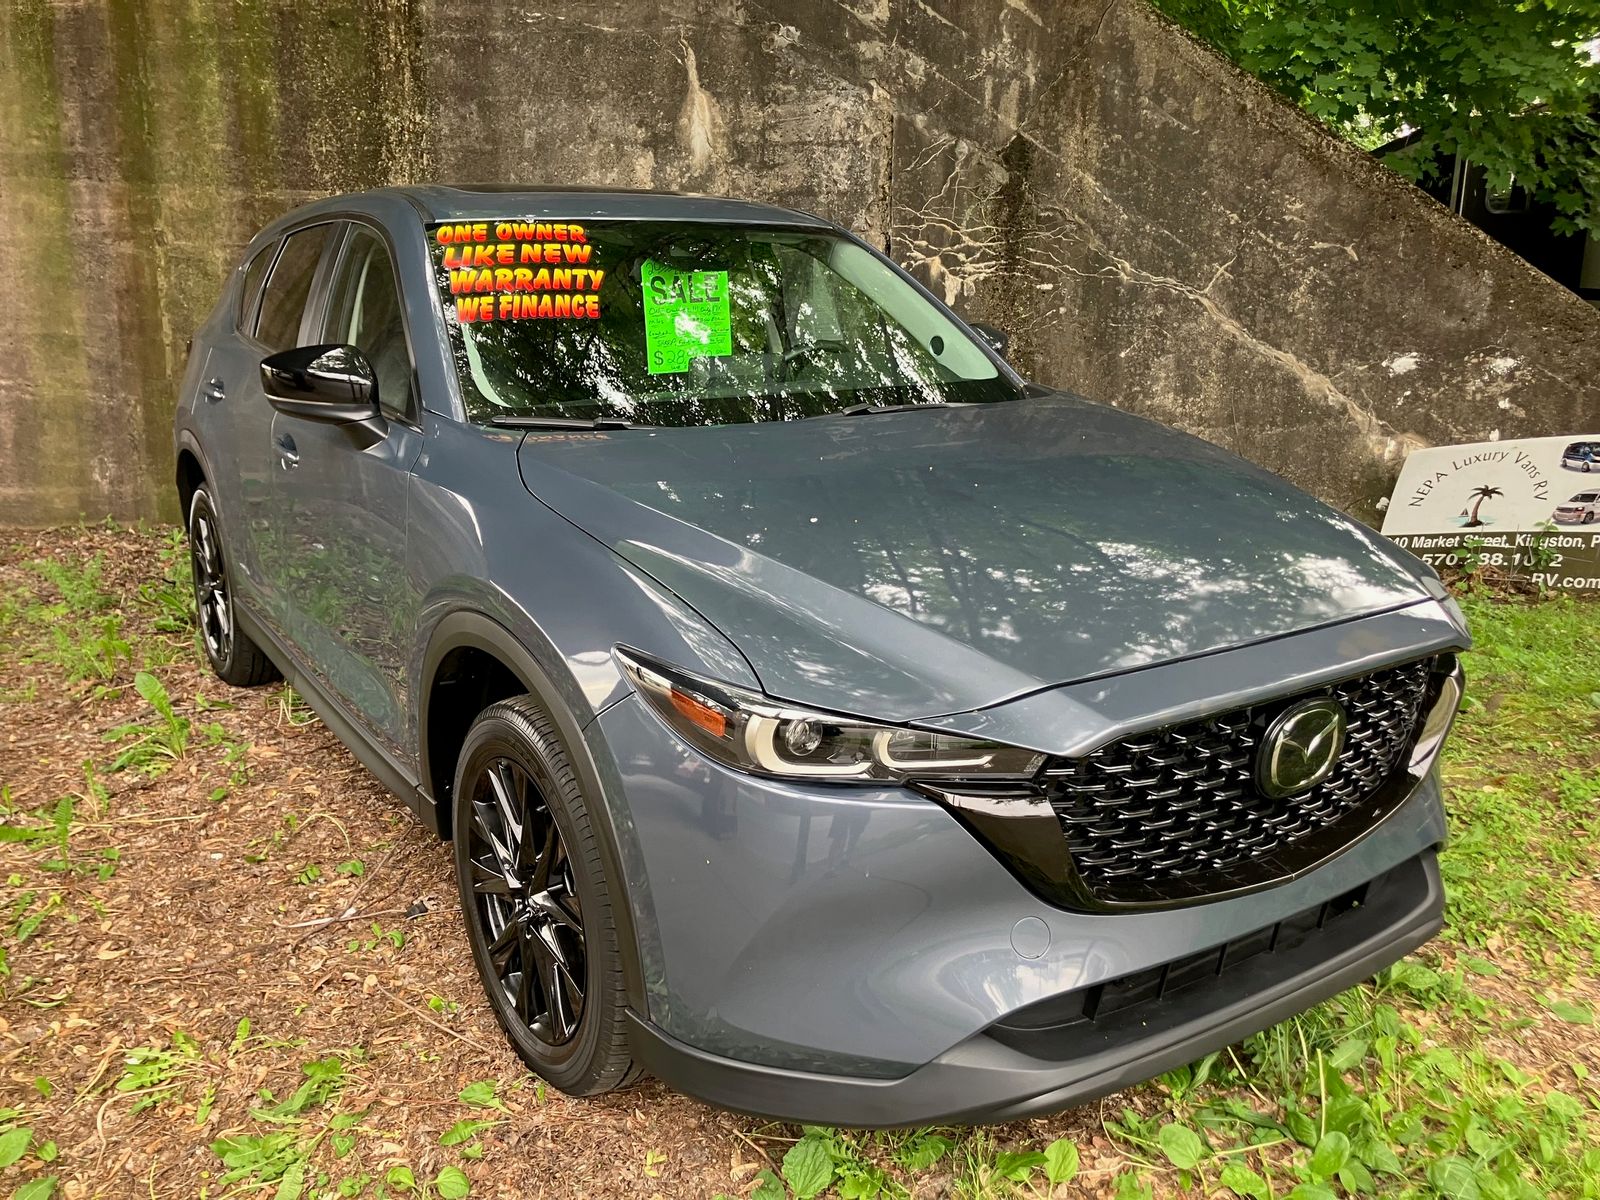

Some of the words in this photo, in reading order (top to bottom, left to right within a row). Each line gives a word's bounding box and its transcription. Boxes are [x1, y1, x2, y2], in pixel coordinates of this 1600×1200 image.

[436, 223, 488, 245] ONE
[495, 223, 587, 243] OWNER
[443, 243, 516, 268] LIKE
[520, 243, 592, 264] NEW
[450, 268, 605, 294] WARRANTY
[650, 274, 721, 306] SALE
[456, 296, 495, 323] WE
[499, 294, 600, 319] FINANCE
[1408, 471, 1449, 507] NEPA
[1452, 451, 1509, 471] Luxury
[1514, 451, 1541, 479] Vans
[1533, 480, 1549, 501] RV
[1411, 535, 1460, 549] Market
